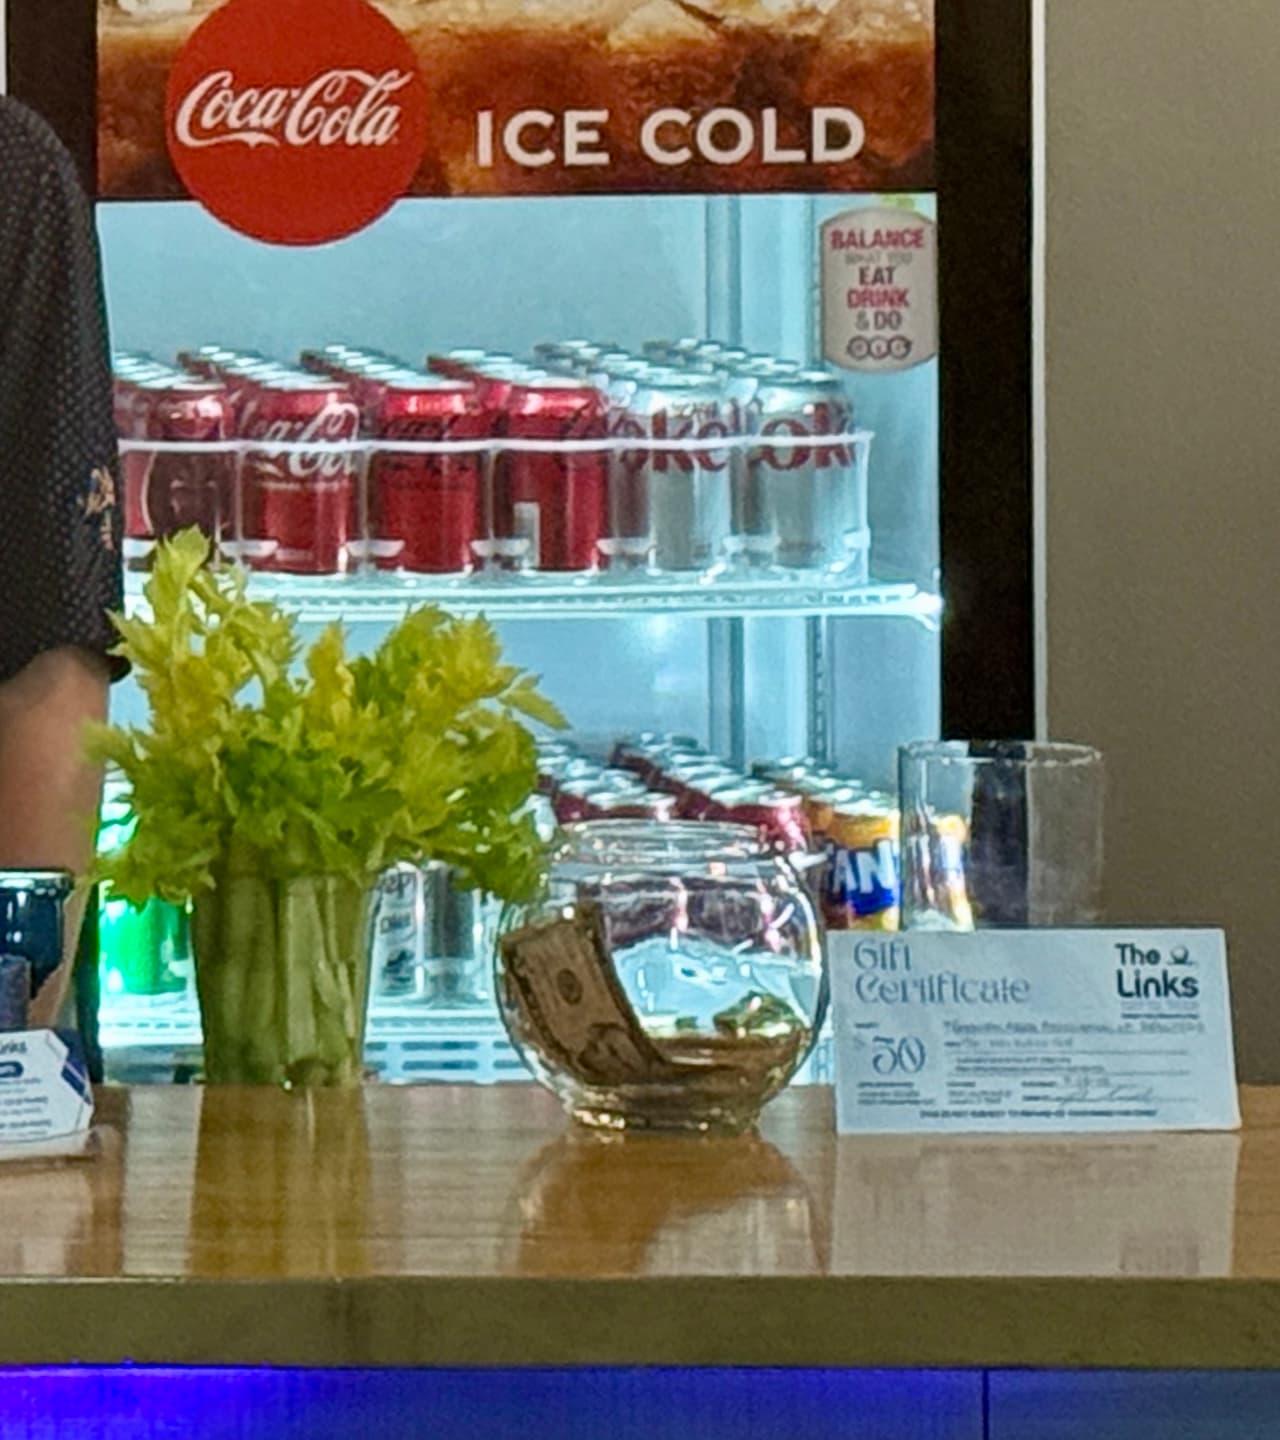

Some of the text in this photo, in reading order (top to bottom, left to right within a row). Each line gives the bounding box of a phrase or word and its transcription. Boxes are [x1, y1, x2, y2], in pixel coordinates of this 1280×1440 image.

[175, 67, 867, 168] Coca-Cola ICE COLD
[830, 227, 924, 250] BALANCE
[858, 266, 896, 286] EAT
[846, 288, 911, 309] DRINK
[873, 310, 903, 331] DO
[853, 939, 912, 972] Gift
[1115, 942, 1161, 967] The
[855, 971, 1031, 1006] Certificate
[1116, 969, 1200, 1000] Links
